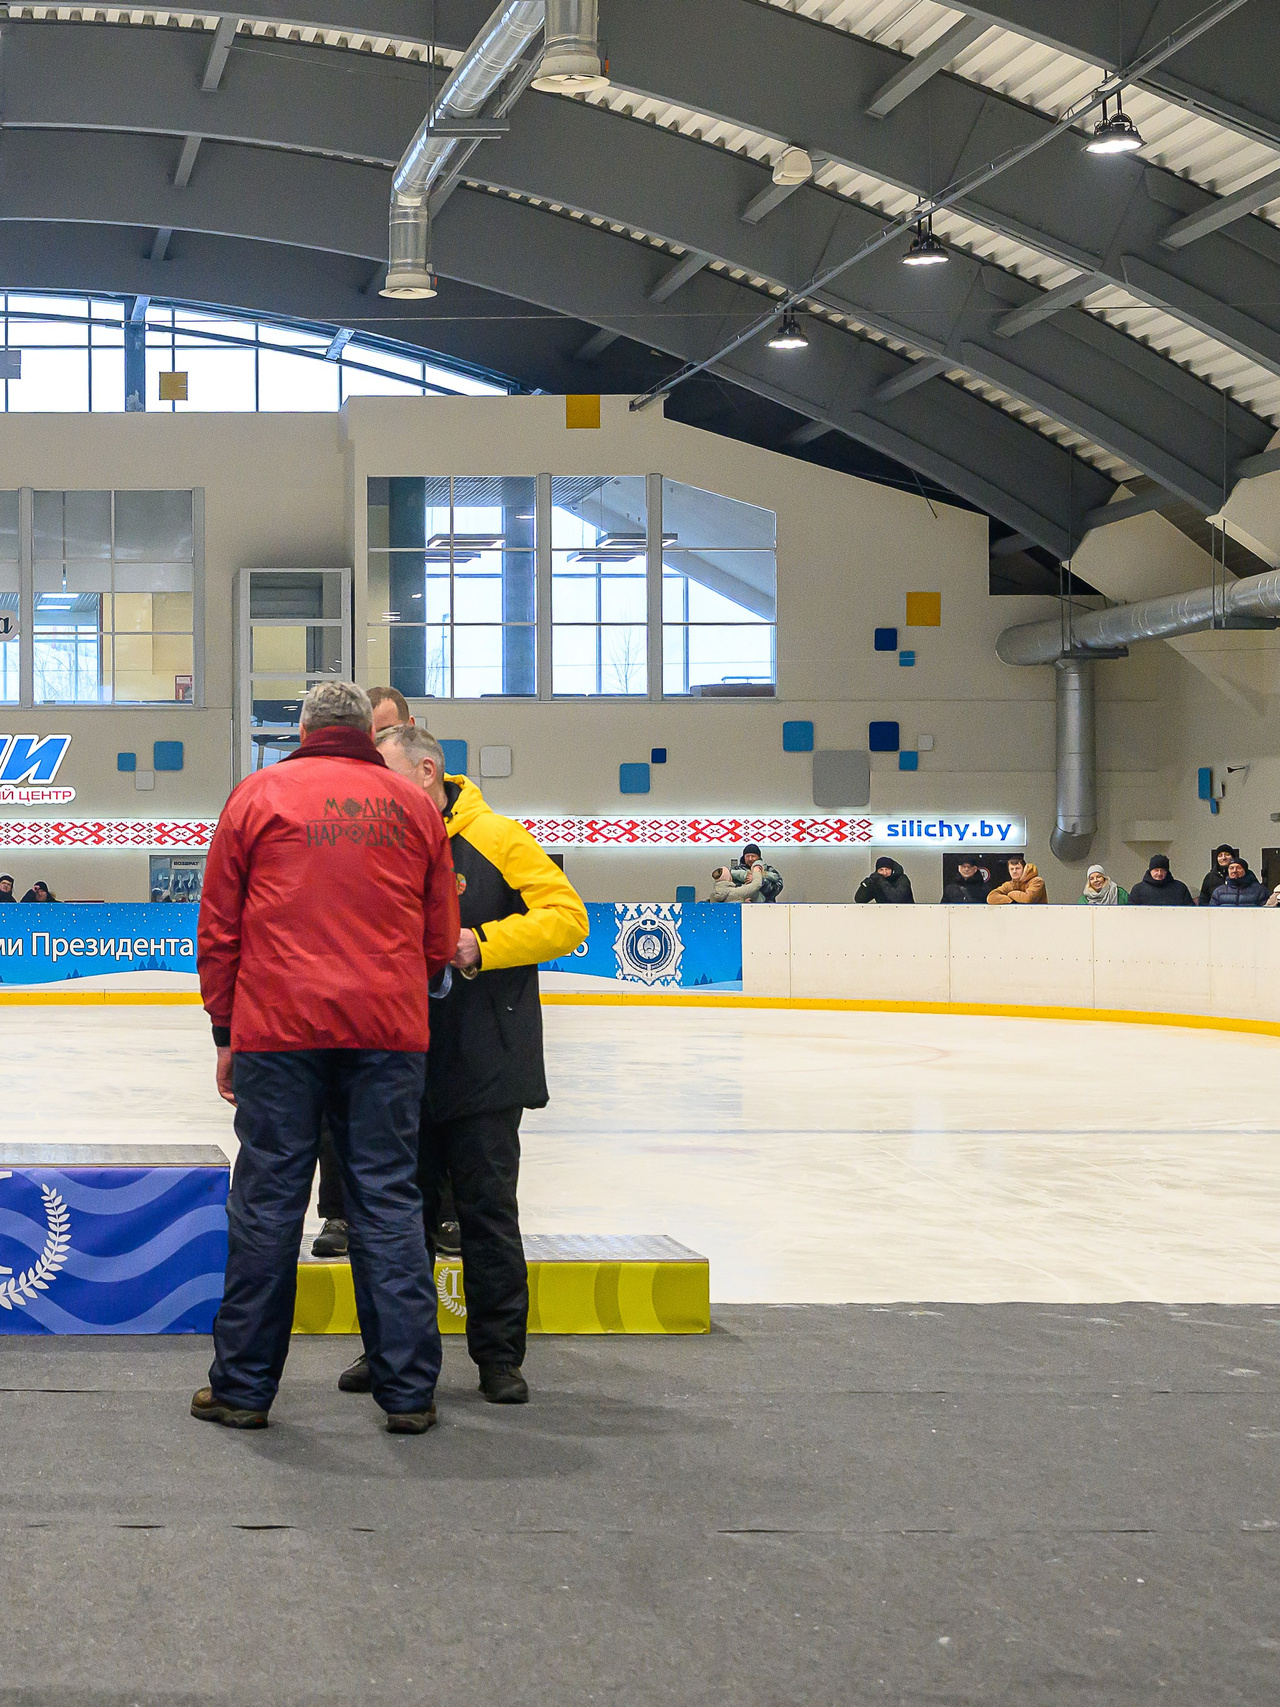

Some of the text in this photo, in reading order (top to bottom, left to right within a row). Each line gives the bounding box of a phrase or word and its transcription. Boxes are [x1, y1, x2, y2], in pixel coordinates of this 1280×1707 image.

[18, 790, 72, 802] ЦЕНТР
[887, 820, 1012, 841] silichy.by
[31, 932, 194, 962] Президента
